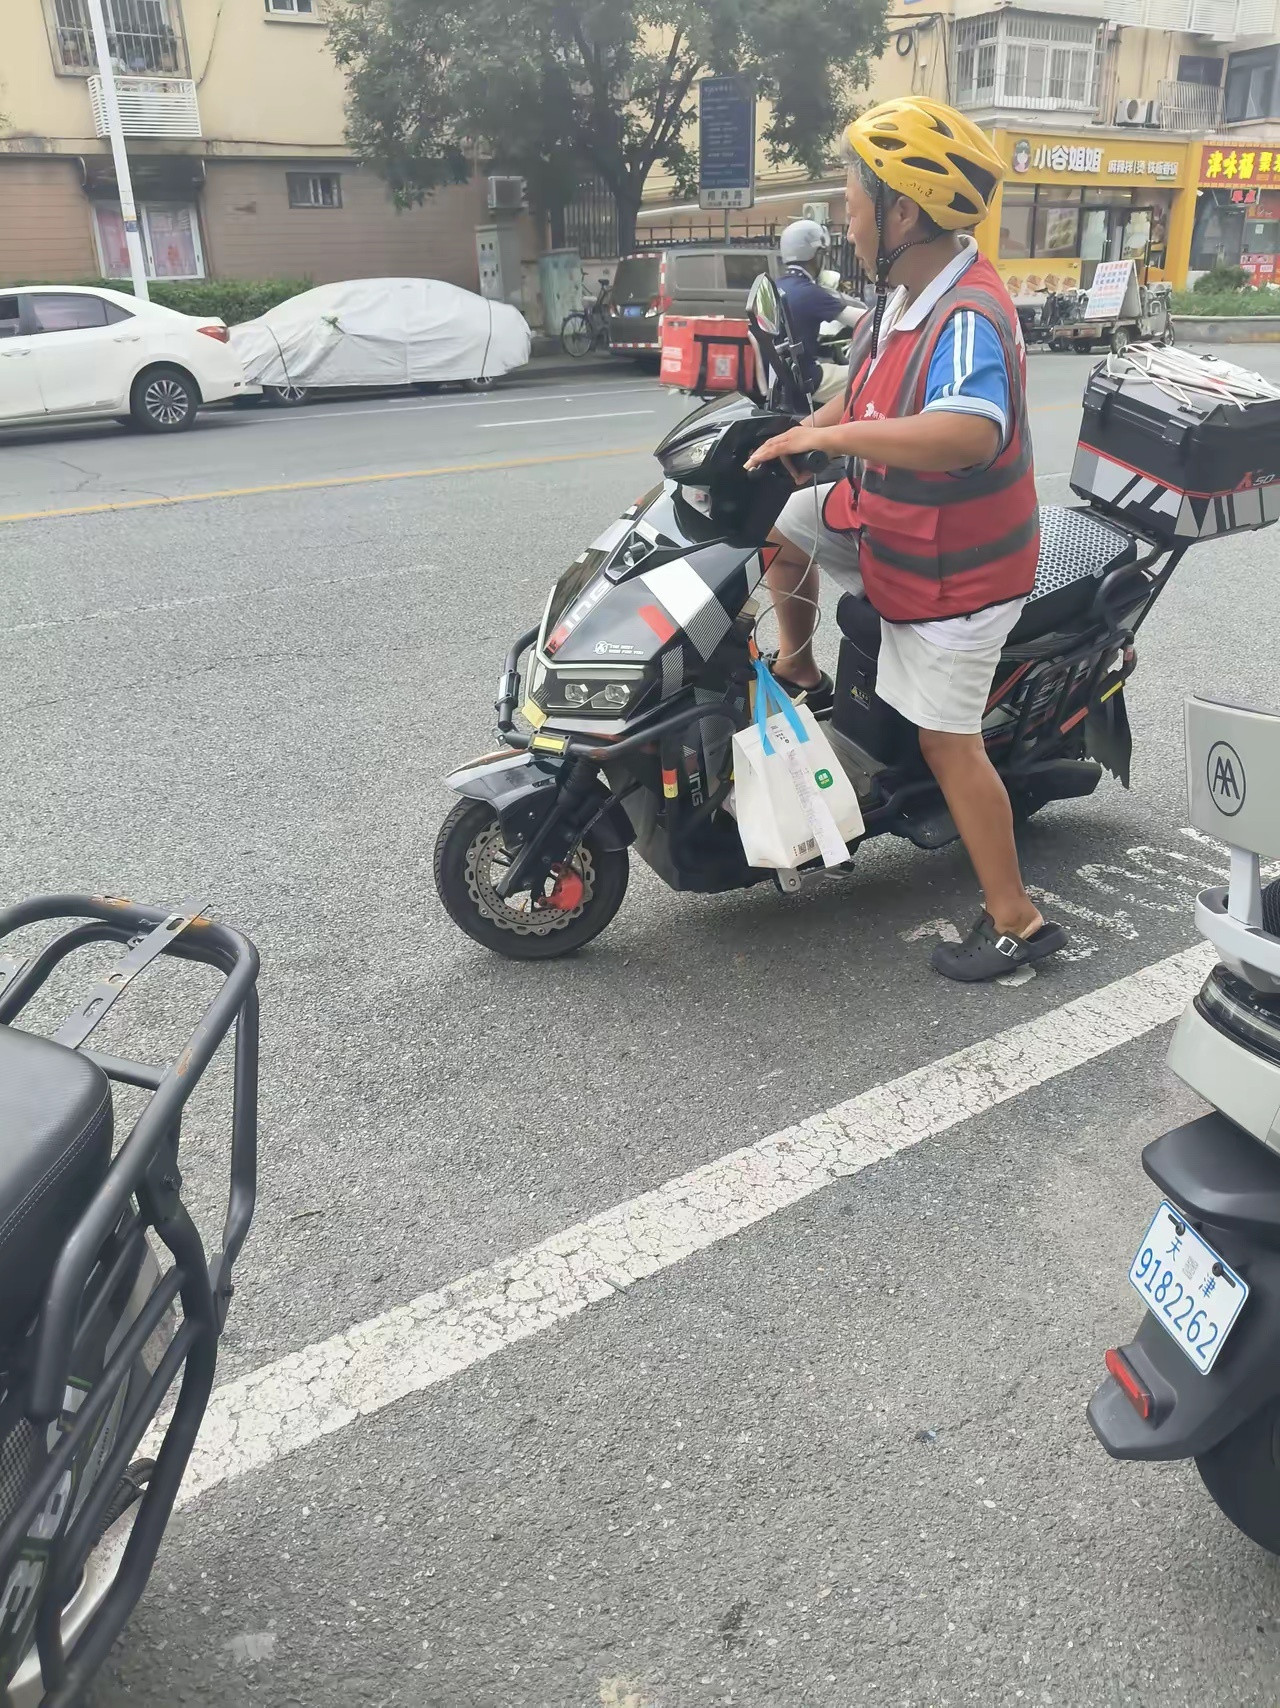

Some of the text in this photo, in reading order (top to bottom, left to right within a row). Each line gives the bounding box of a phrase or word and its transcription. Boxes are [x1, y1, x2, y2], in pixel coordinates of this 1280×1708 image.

[1033, 144, 1104, 173] 小谷姐姐
[1135, 1247, 1219, 1360] 9182262
